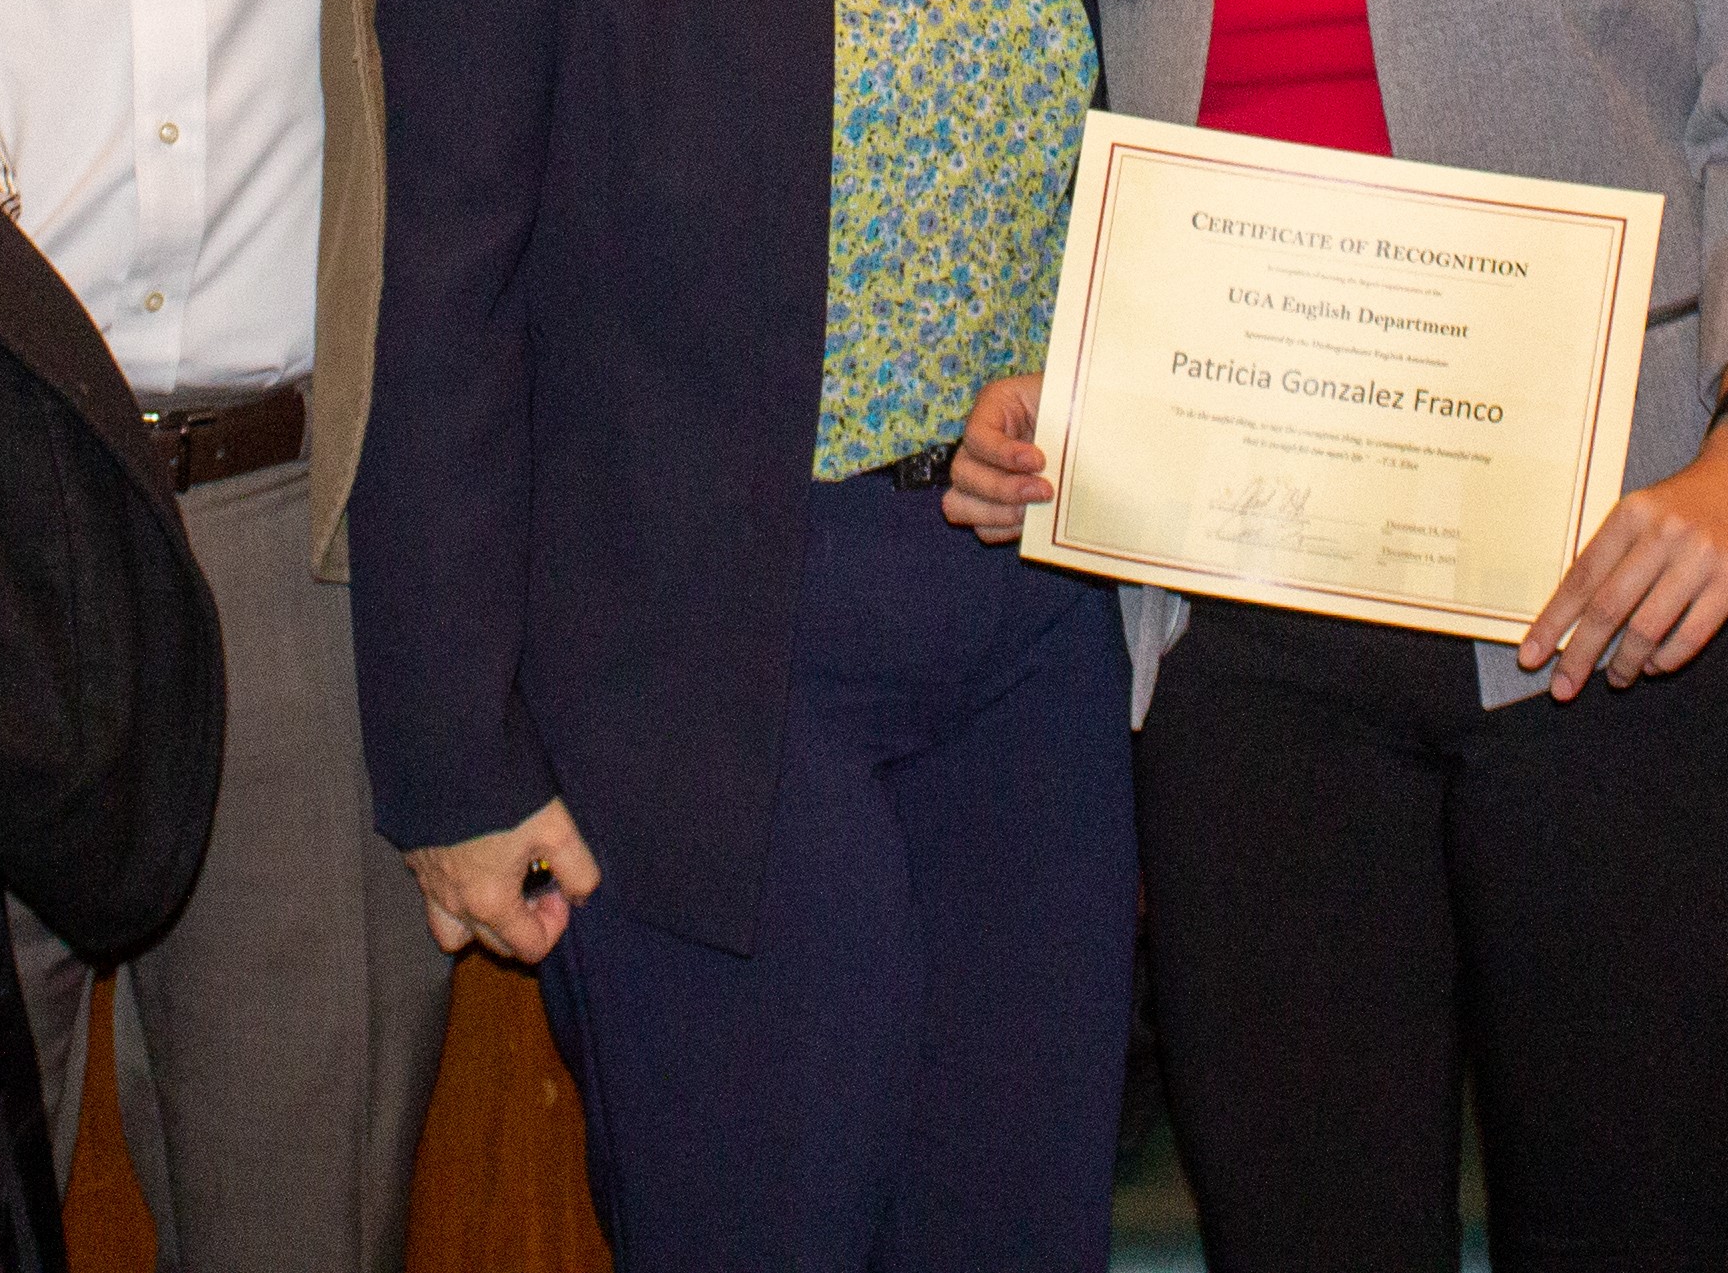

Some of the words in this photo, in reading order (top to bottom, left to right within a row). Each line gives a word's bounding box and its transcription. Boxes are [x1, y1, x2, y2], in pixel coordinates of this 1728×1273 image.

[1190, 210, 1332, 249] CERTIFICATE
[1339, 237, 1368, 254] OF
[1375, 239, 1528, 278] RECOGNITION
[1227, 286, 1274, 309] UGA
[1281, 295, 1350, 321] English
[1357, 306, 1468, 338] Department
[1171, 350, 1271, 389] Patricia
[1281, 368, 1404, 410] Gonzalez
[1413, 387, 1503, 424] Franco
